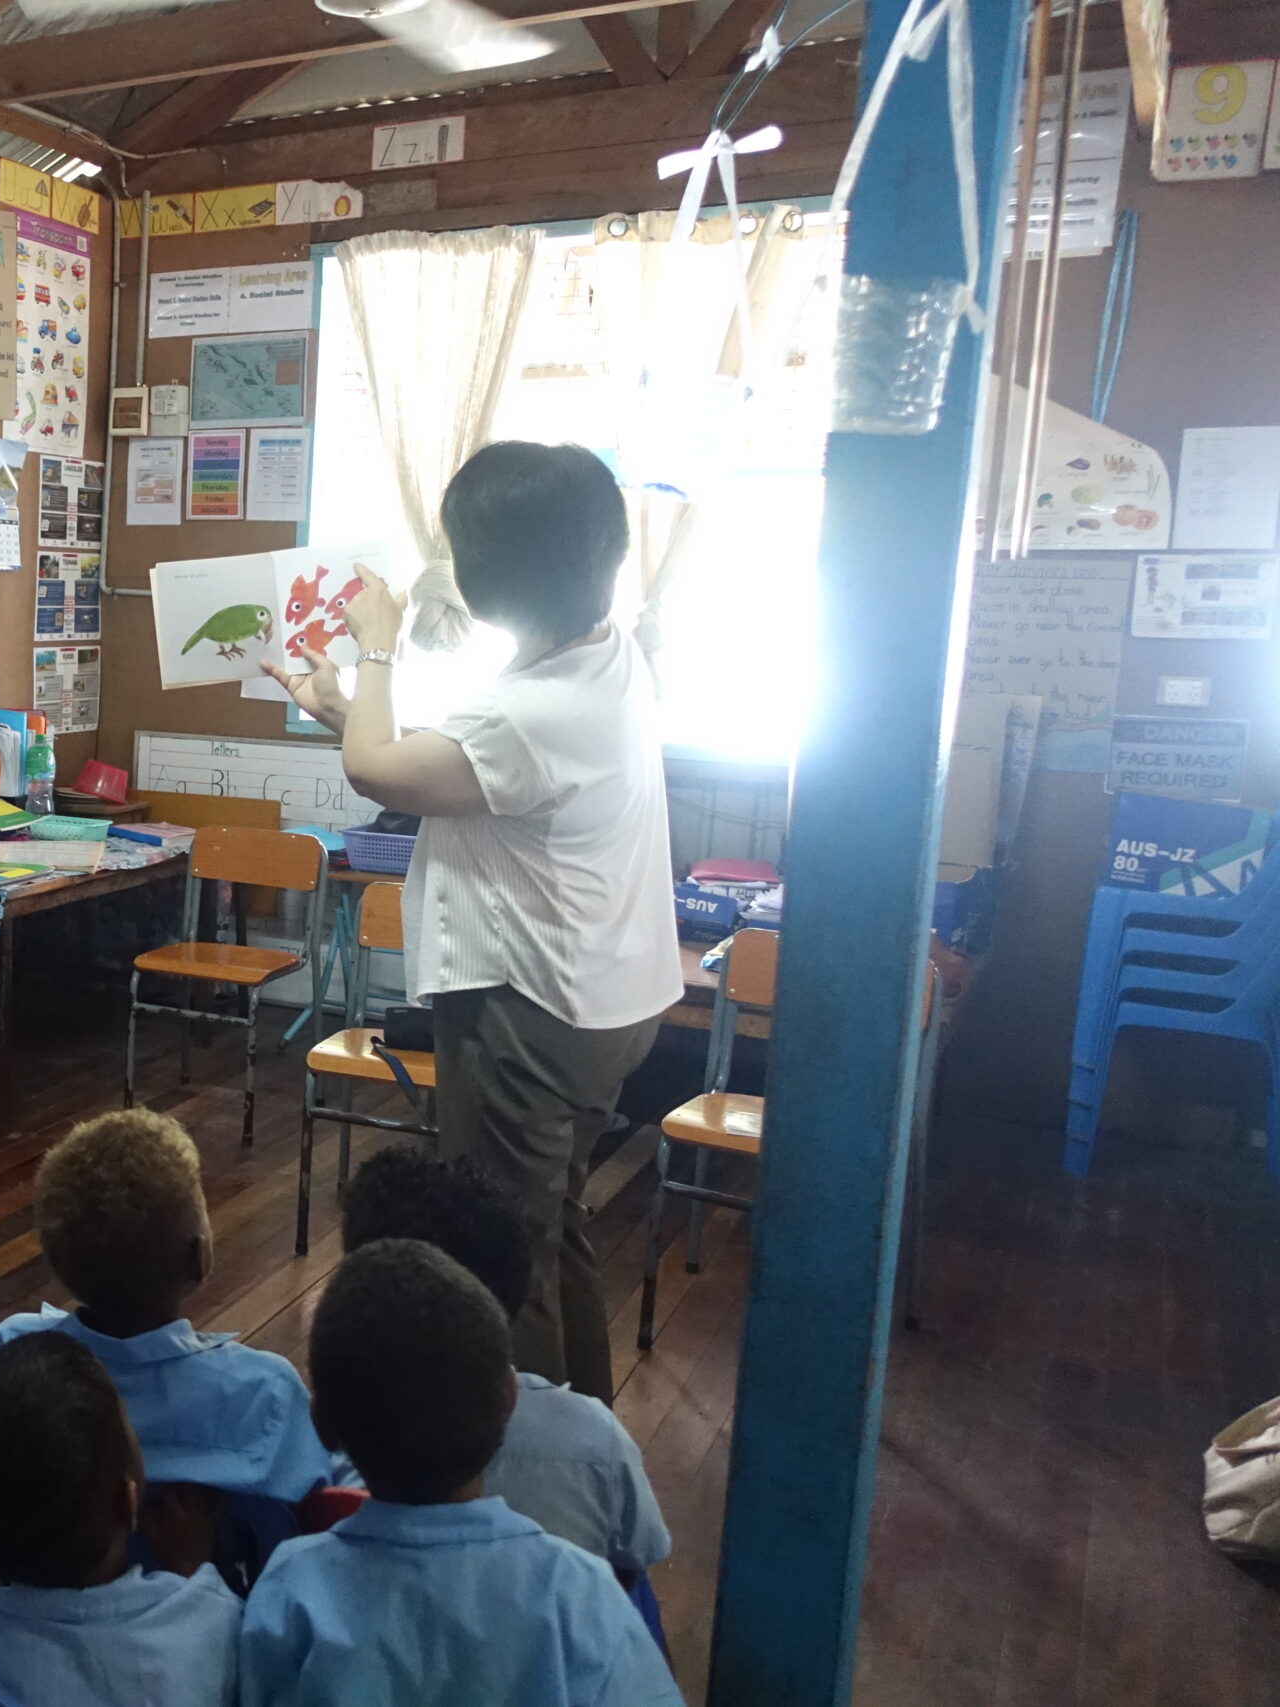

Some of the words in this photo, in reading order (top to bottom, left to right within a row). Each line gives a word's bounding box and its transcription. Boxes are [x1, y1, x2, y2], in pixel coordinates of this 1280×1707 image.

[1192, 64, 1247, 124] 9
[239, 271, 282, 287] Learning
[284, 269, 308, 283] Area
[249, 290, 273, 299] Social
[275, 288, 305, 297] Studies
[205, 438, 229, 447] Sunday
[201, 483, 229, 492] Thursday
[1143, 723, 1237, 745] DANGER
[210, 741, 242, 758] letters
[1116, 750, 1168, 767] FACE
[1175, 752, 1234, 770] MASK
[1120, 770, 1227, 789] REQUIRED
[1115, 838, 1197, 864] AUS-JZ
[1113, 855, 1139, 872] 80
